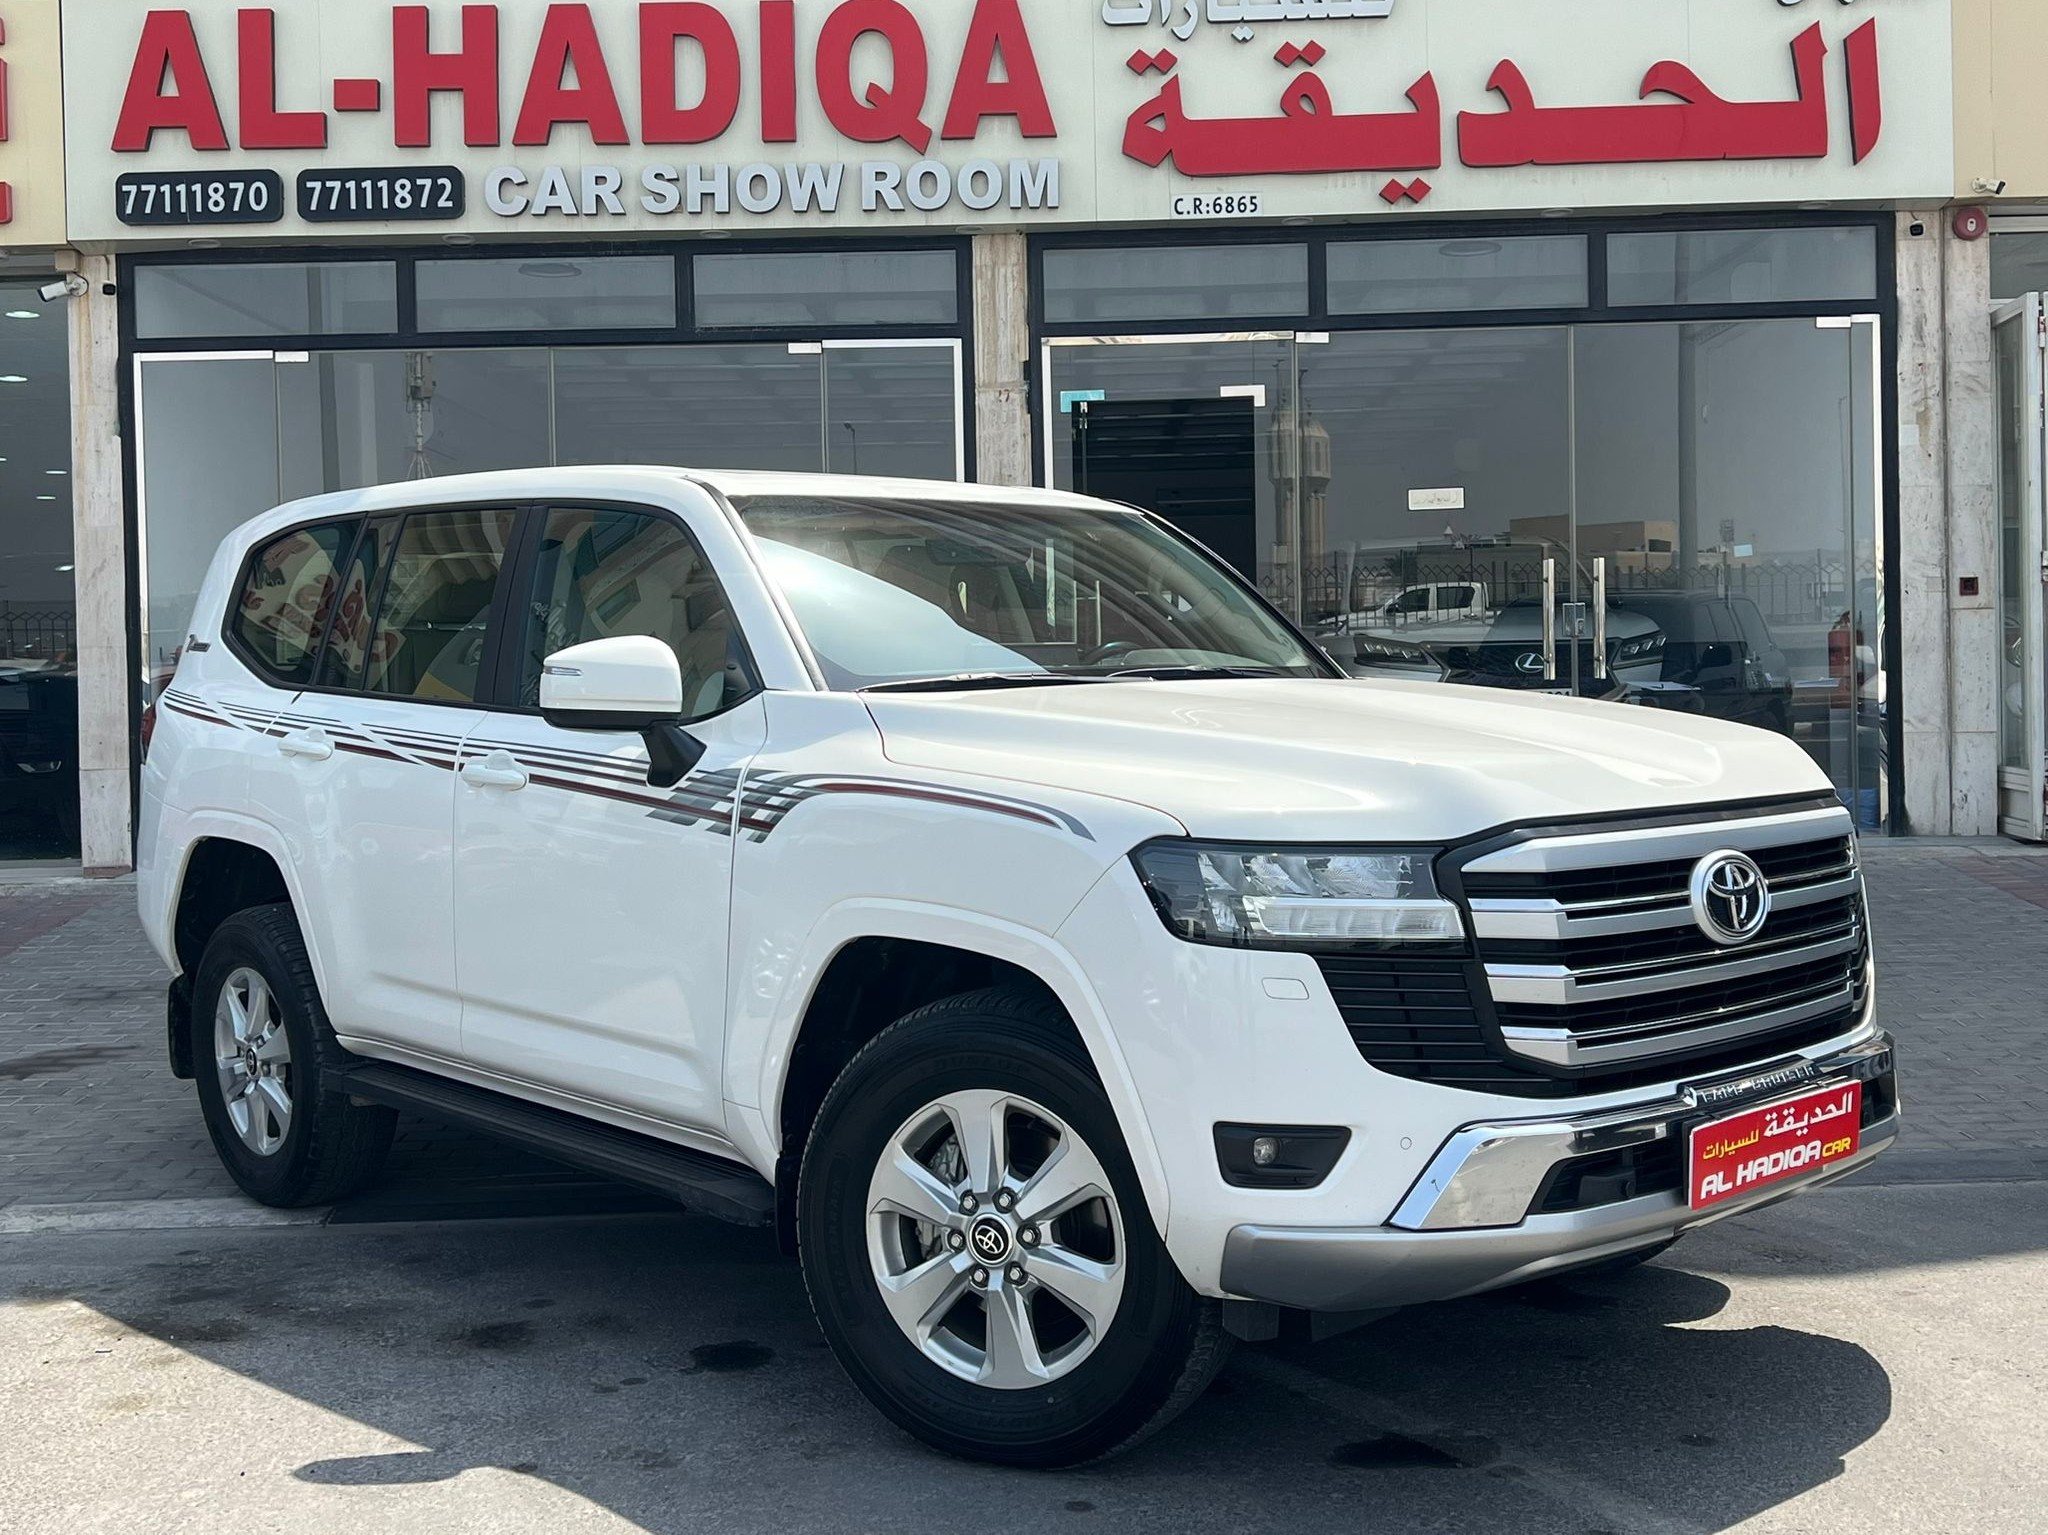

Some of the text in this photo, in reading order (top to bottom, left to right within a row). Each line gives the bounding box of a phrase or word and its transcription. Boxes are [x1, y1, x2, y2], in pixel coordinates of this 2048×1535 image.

[111, 0, 1057, 155] AL-HADIQA
[1122, 16, 1882, 206] الحديقة
[121, 182, 269, 215] 77111870
[305, 177, 455, 212] 77111872
[484, 158, 1060, 216] CAR SHOW ROOM
[1173, 194, 1260, 217] C.R:6865
[1702, 1090, 1854, 1160] الحديقة للسيارات
[1700, 1136, 1852, 1201] AL HADIQA CAR
